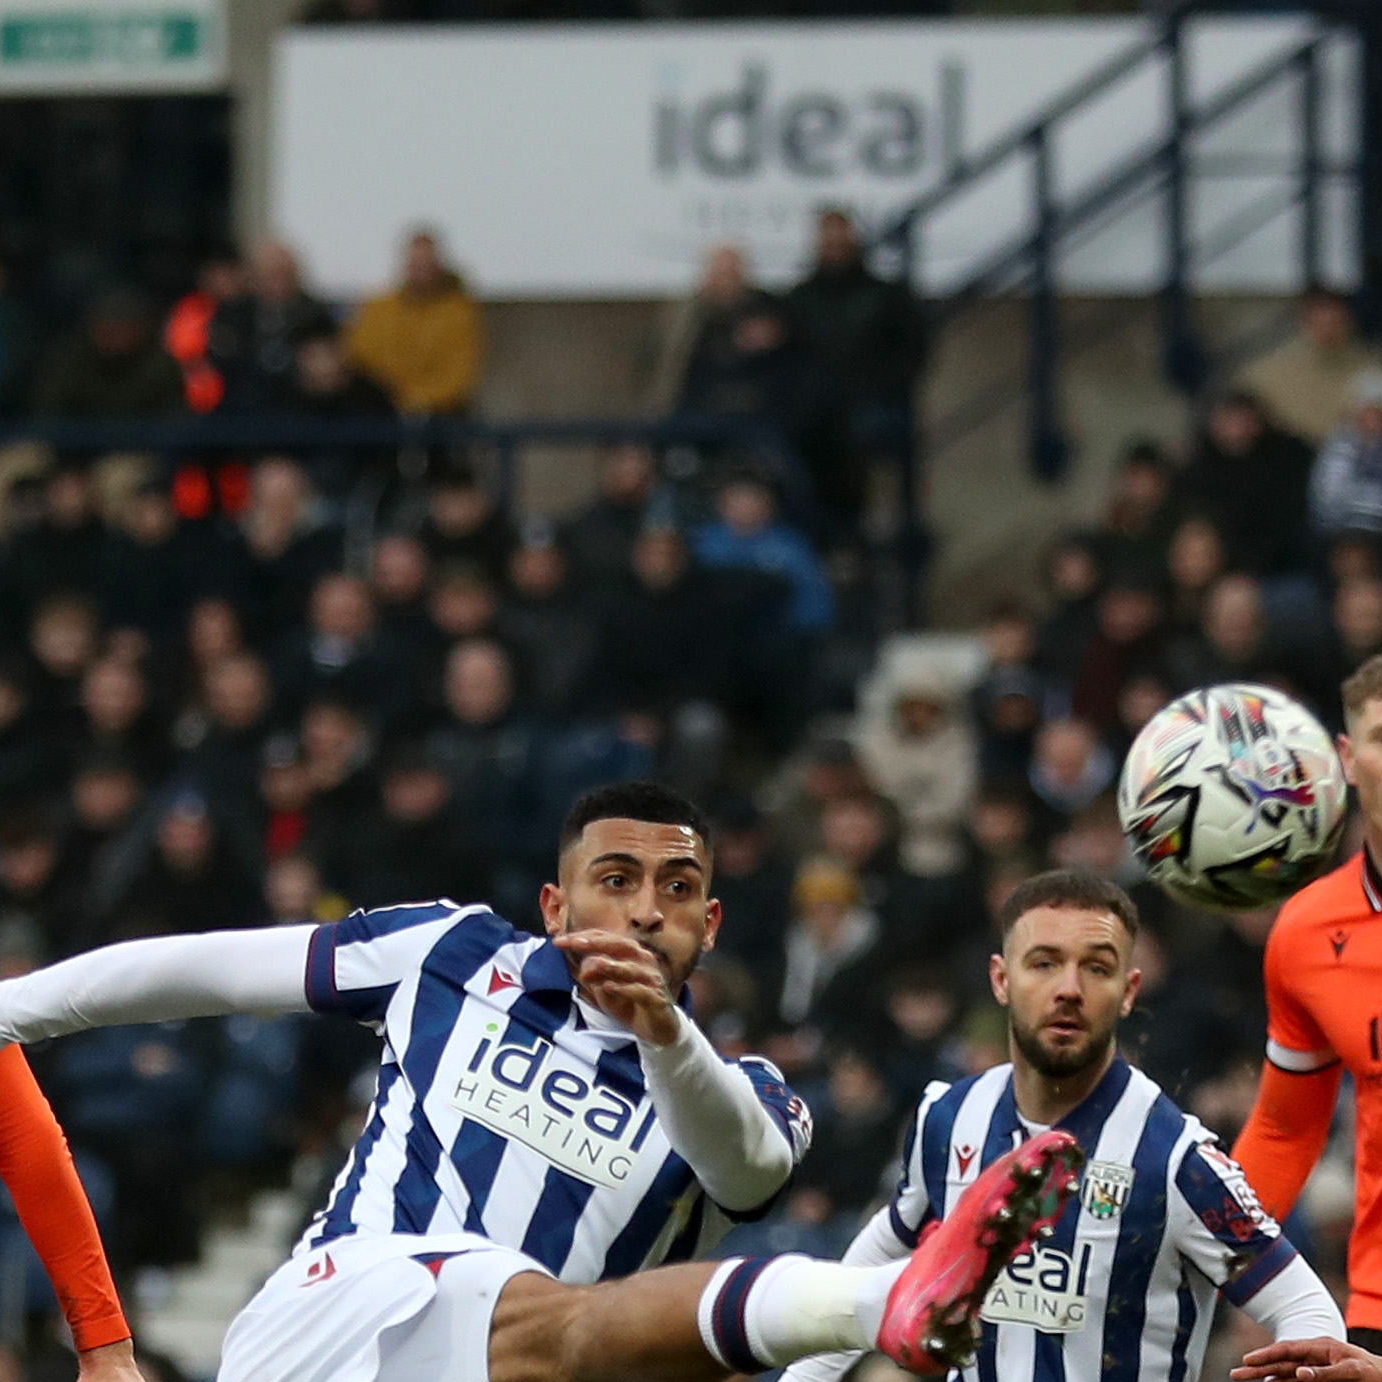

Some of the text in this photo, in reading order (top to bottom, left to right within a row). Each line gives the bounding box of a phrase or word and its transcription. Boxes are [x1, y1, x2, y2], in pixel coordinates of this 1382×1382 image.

[653, 60, 967, 180] ideal
[453, 1078, 633, 1181] HEATING
[466, 1022, 658, 1154] ideal
[990, 1287, 1085, 1323] ATING
[1007, 1243, 1092, 1297] eal
